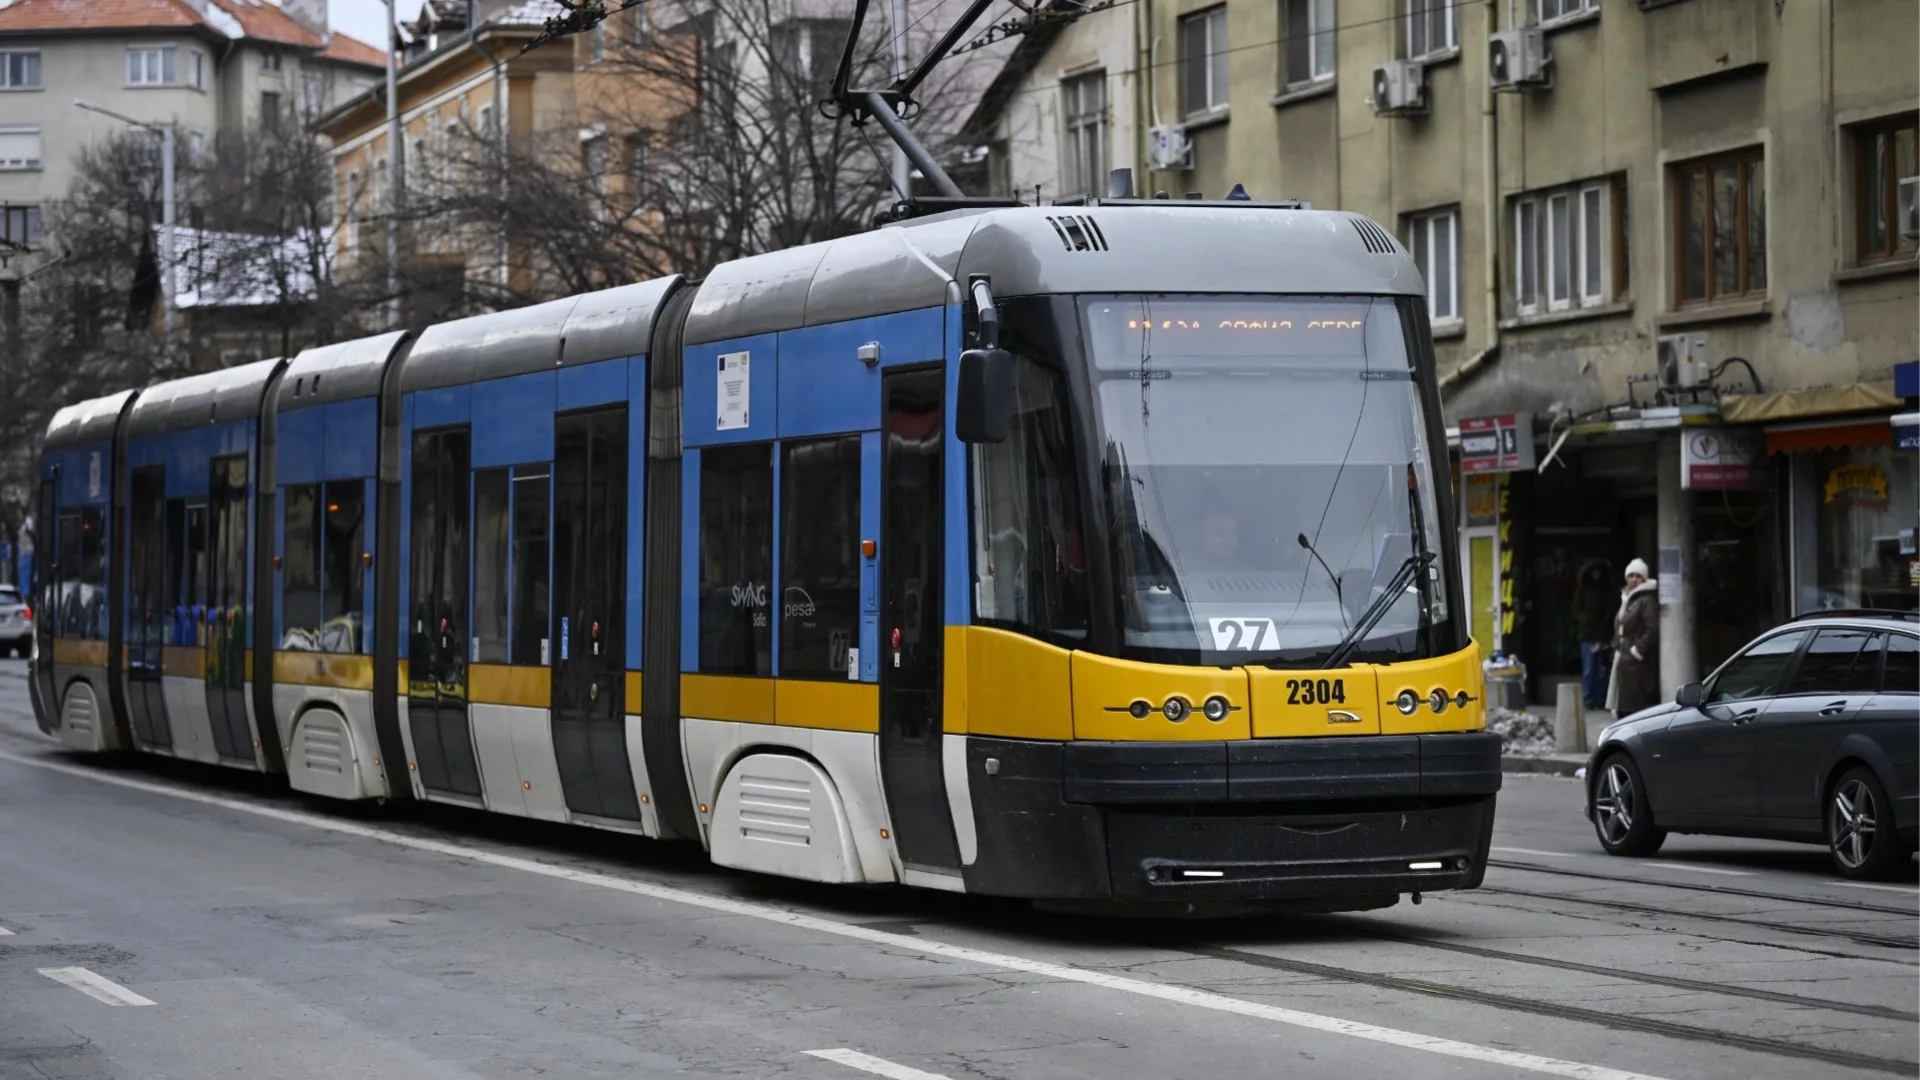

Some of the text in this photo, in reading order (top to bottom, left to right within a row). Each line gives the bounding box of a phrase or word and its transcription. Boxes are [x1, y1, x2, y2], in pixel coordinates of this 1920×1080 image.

[730, 581, 766, 608] SWING
[752, 611, 767, 628] Sofia
[784, 602, 813, 621] pesa
[1217, 619, 1270, 651] 27
[1285, 678, 1346, 705] 2304
